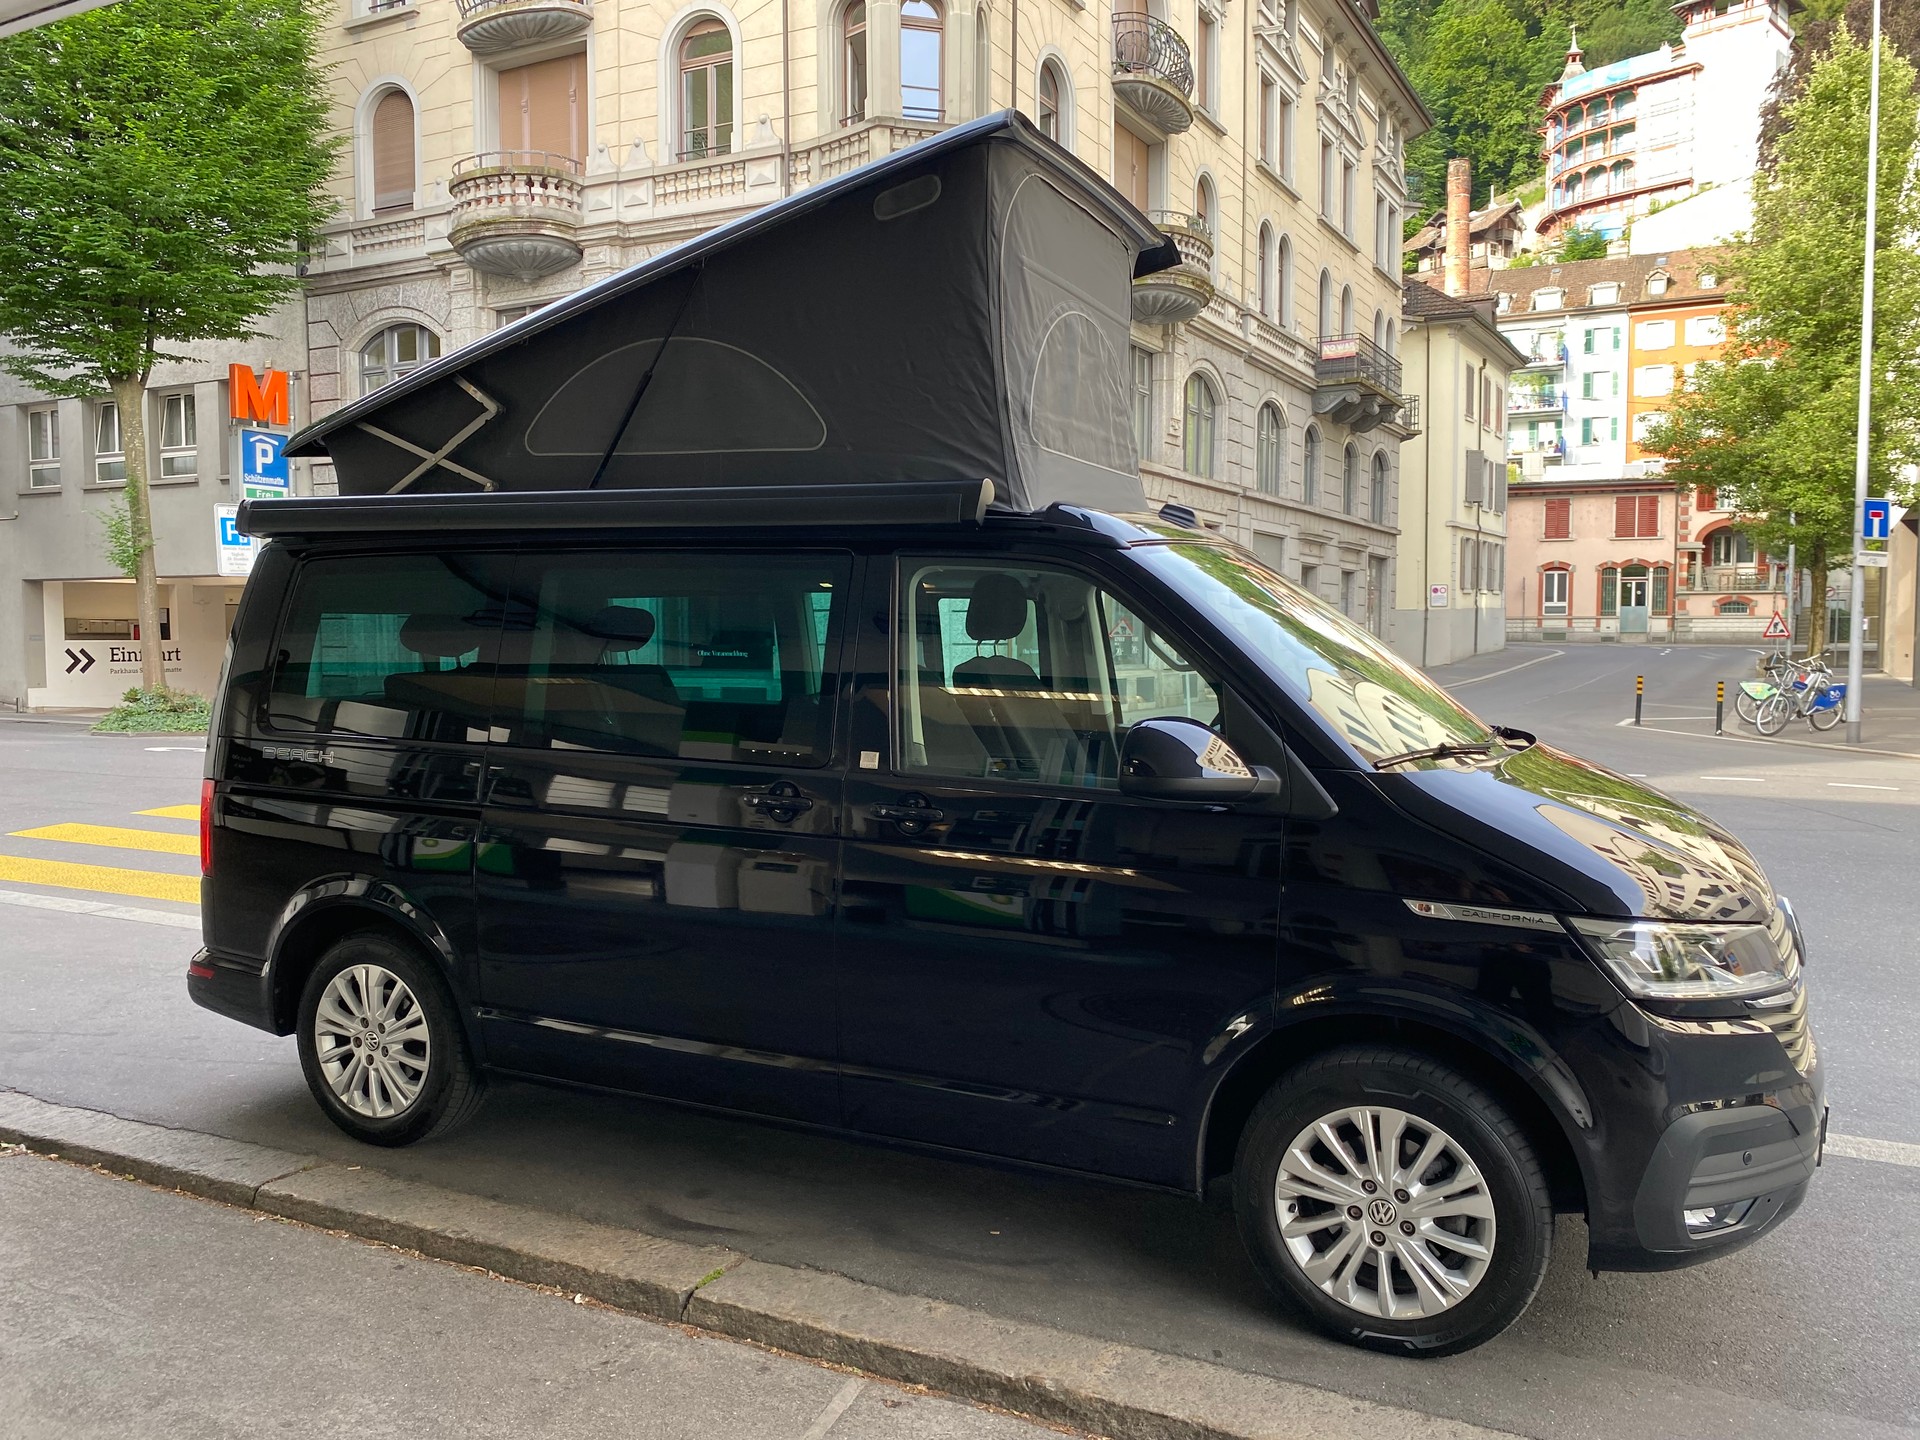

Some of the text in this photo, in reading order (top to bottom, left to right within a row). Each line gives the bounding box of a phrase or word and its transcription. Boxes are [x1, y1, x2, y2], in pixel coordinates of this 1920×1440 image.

[229, 363, 289, 425] M
[255, 442, 274, 474] P
[244, 473, 284, 486] Schützenmatte
[256, 489, 274, 498] Frei
[262, 746, 334, 764] BEACH
[1462, 910, 1545, 924] CALIFORNIA
